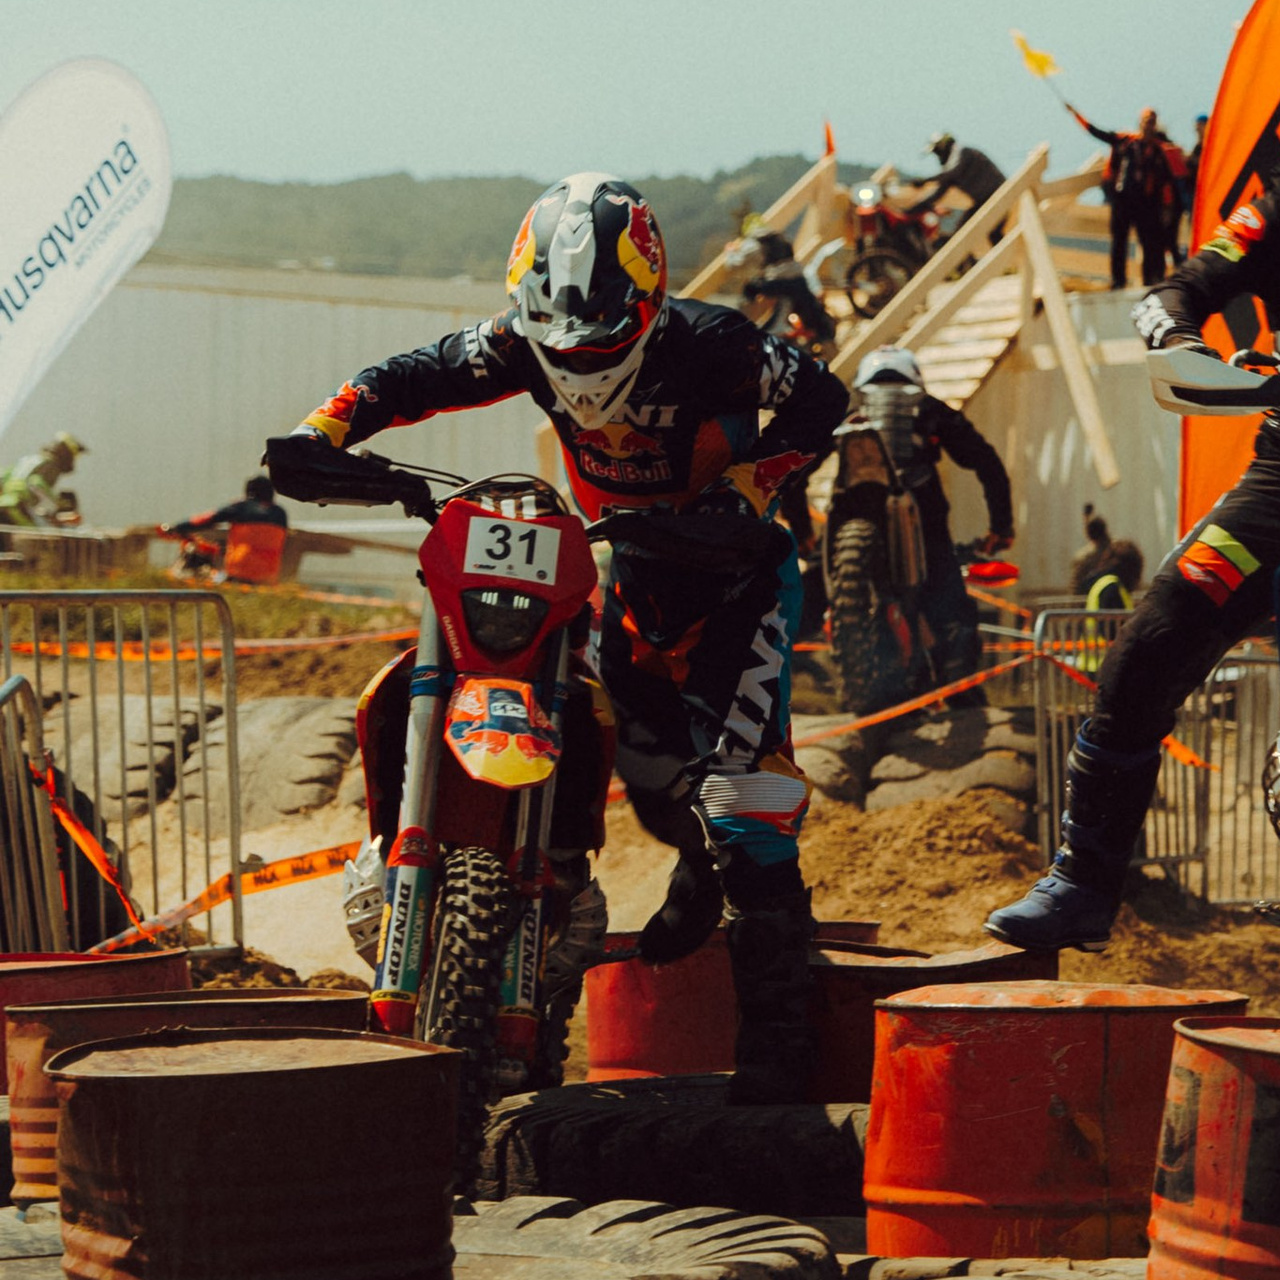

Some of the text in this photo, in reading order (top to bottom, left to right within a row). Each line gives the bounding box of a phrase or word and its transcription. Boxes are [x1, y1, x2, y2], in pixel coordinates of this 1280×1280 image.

[580, 449, 673, 483] Red Bull
[485, 523, 538, 565] 31
[388, 880, 412, 987] DUNLOP
[406, 910, 426, 971] MOTOREX
